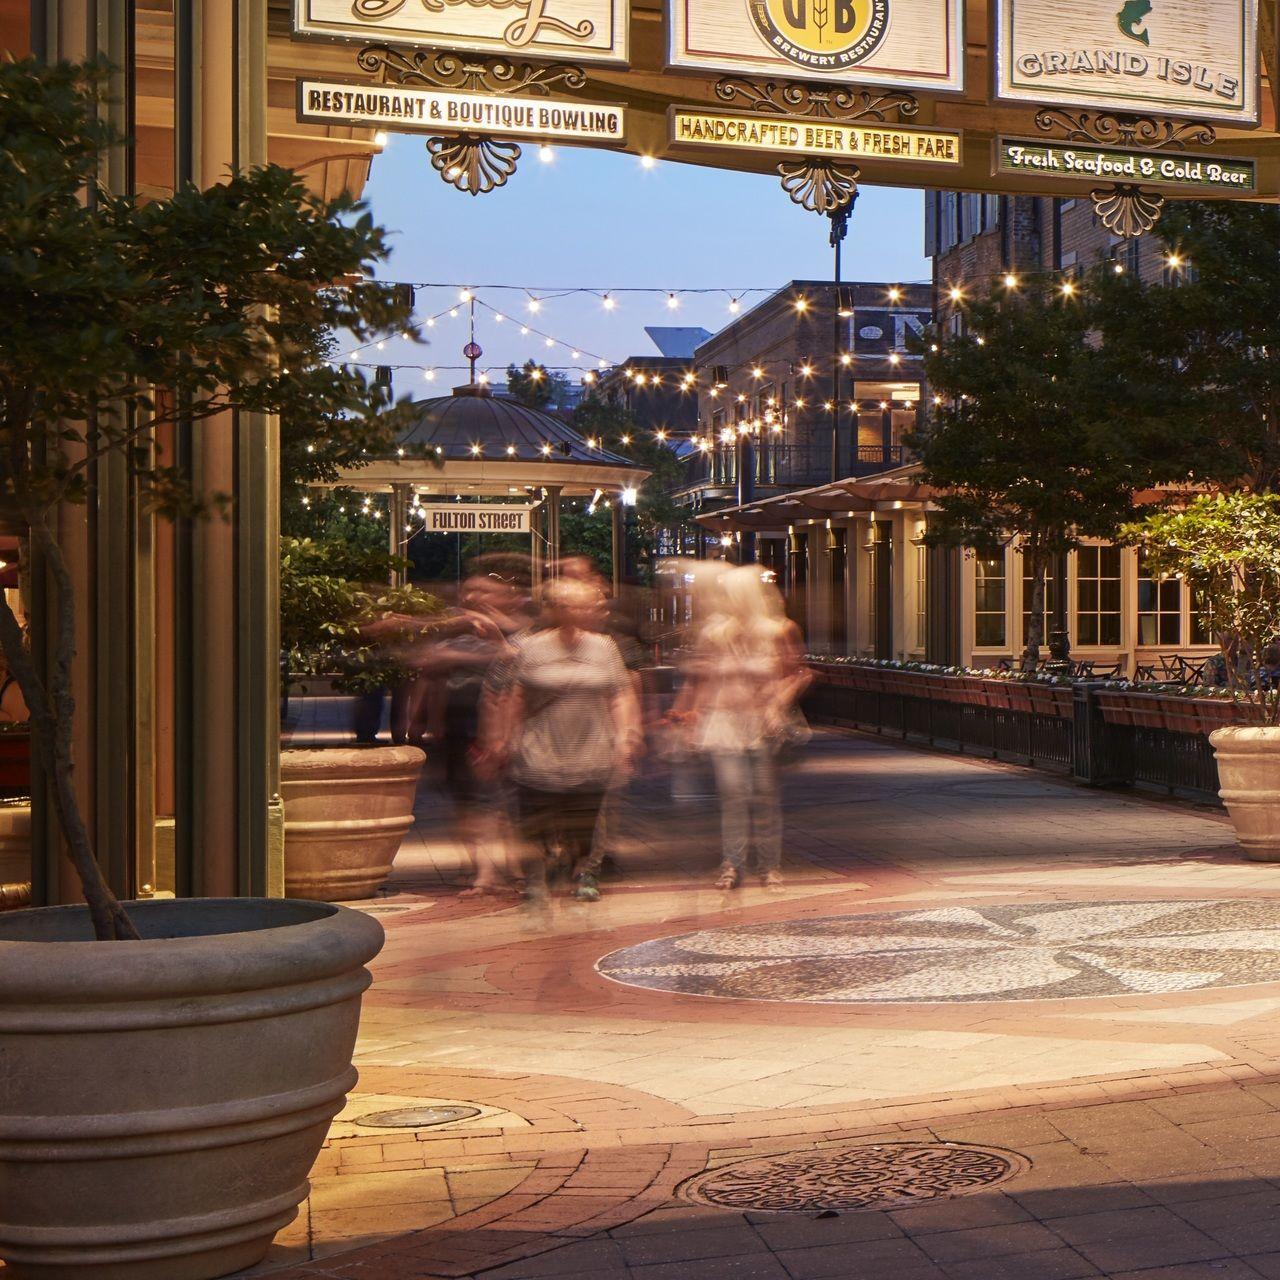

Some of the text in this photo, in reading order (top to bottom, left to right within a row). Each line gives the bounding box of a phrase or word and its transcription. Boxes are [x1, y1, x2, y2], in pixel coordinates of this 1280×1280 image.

[772, 35, 836, 65] BREWERY
[1018, 49, 1239, 99] GRAND ISLE
[308, 89, 618, 134] RESTAURANT & BOUTIQUE BOWLING
[681, 117, 955, 158] HANDCRAFTED BEER & FRESH FARE
[1007, 146, 1247, 184] Fresh Seafood & Cold Beer
[432, 512, 475, 529] FULTON
